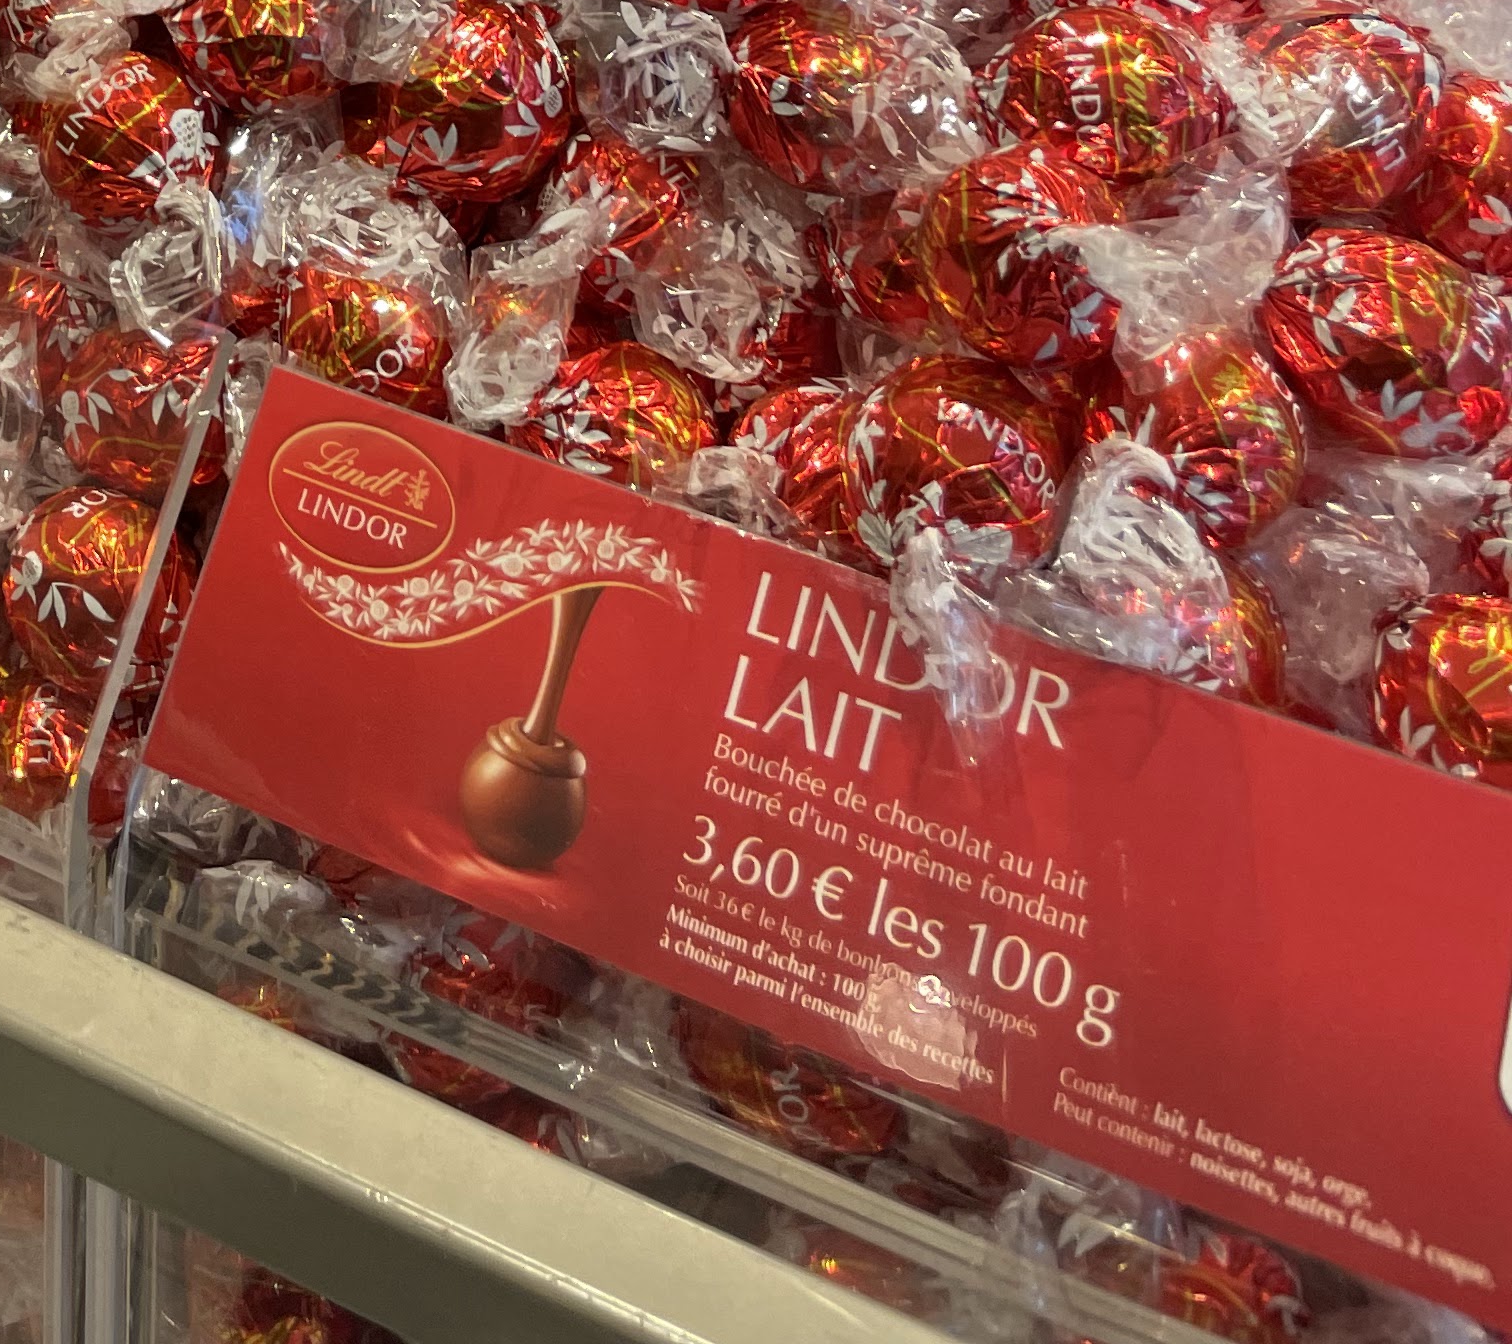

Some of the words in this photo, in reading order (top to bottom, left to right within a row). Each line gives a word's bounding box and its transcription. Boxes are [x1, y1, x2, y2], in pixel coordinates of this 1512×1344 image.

[56, 65, 157, 158] LINDOR
[303, 440, 407, 497] Lindt
[296, 487, 409, 551] LINDOR
[724, 655, 902, 772] LAIT
[704, 766, 782, 817] fourré
[789, 801, 847, 845] d'un
[857, 834, 973, 893] suprême
[979, 874, 1088, 938] fondant
[714, 733, 826, 798] Bouchée
[833, 781, 867, 813] de
[874, 799, 992, 864] chocolat
[999, 848, 1034, 879] au
[1044, 853, 1088, 900] lait
[666, 903, 748, 952] Minimum
[752, 937, 817, 981] d'achat
[674, 874, 712, 904] Soit
[758, 905, 776, 931] le
[780, 915, 802, 948] kg
[808, 928, 833, 955] de
[868, 878, 946, 959] les
[659, 929, 672, 948] à
[674, 939, 732, 975] choisir
[733, 960, 787, 998] parmi
[789, 979, 884, 1039] l'ensemble
[887, 1021, 918, 1054] des
[923, 1038, 995, 1084] recettes
[1053, 1091, 1093, 1126] Peut
[1097, 1115, 1175, 1158] contenir
